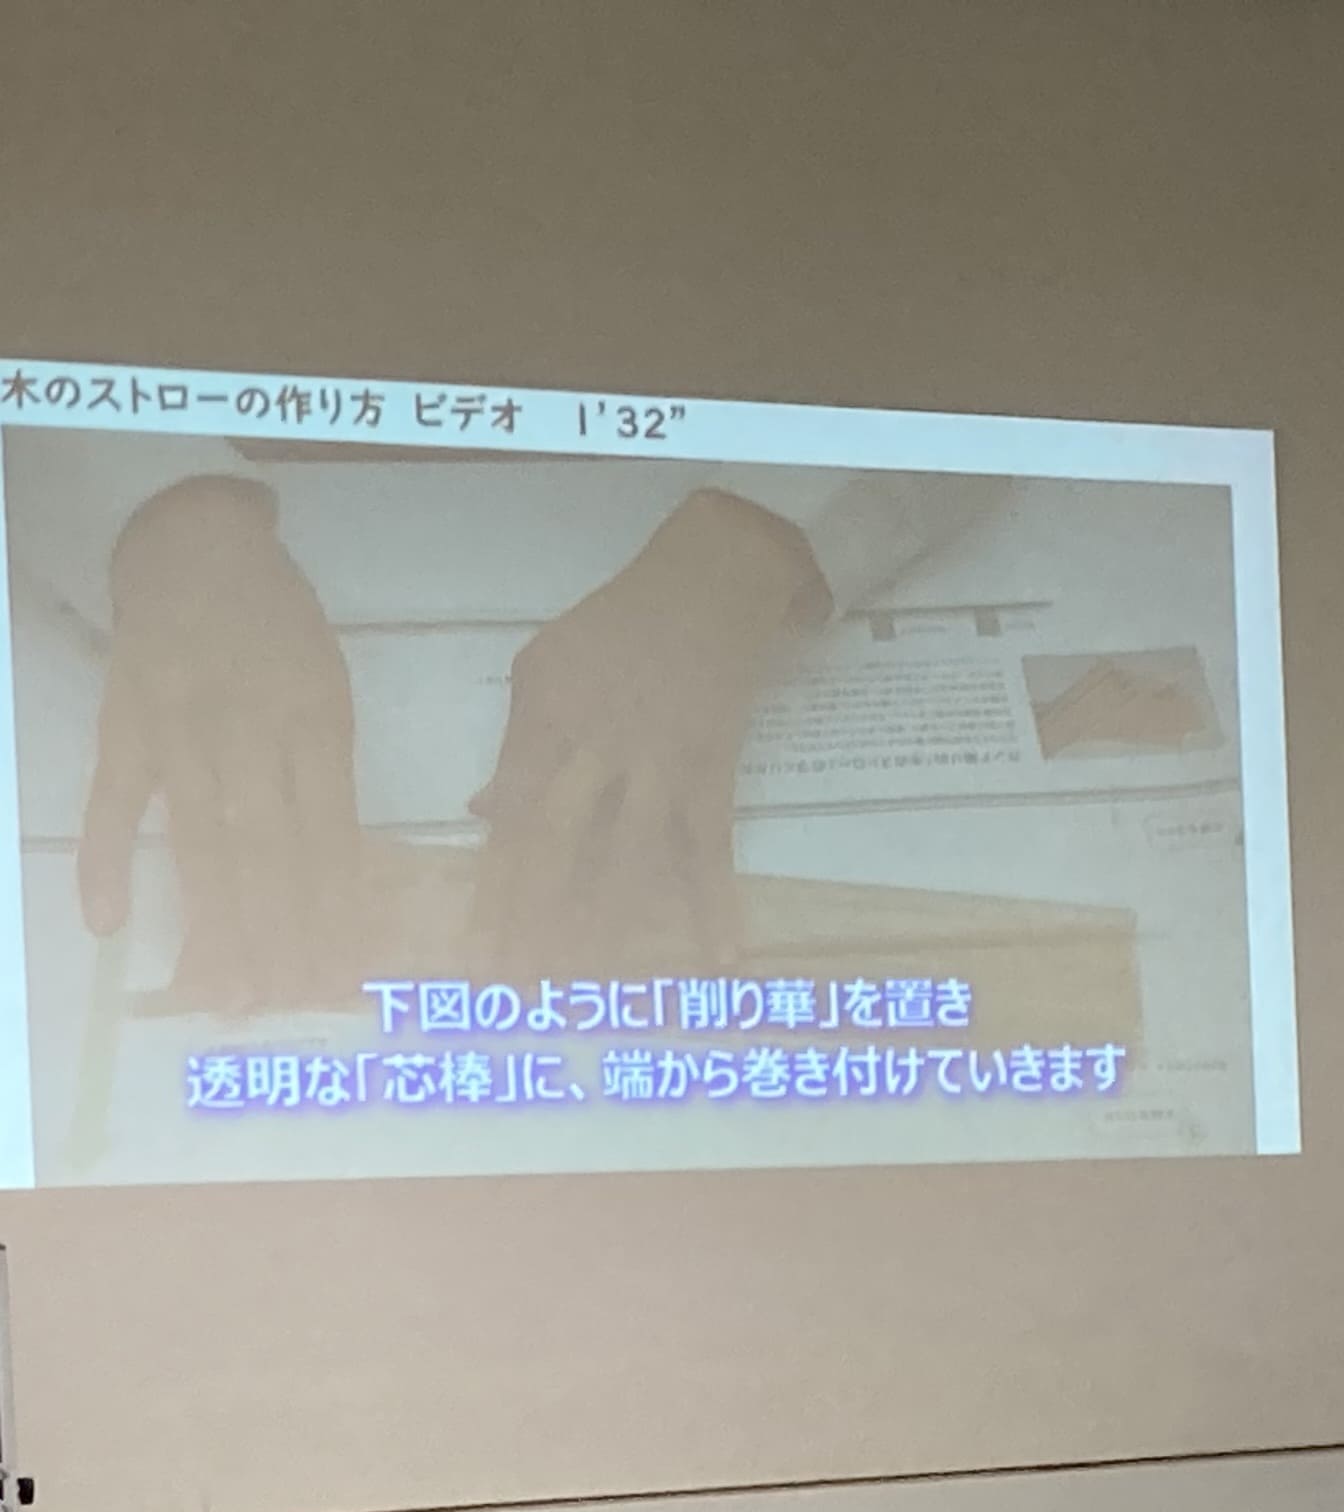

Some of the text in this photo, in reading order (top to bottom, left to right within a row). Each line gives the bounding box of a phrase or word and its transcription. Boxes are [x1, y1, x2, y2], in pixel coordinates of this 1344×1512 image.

[1, 368, 386, 427] 木のストローの作り方
[414, 391, 523, 434] ビデオ
[361, 976, 972, 1033] 下図のように「削り華」を置き
[182, 1041, 1127, 1109] 透明な「芯棒」に、端から巻き付けていきます
